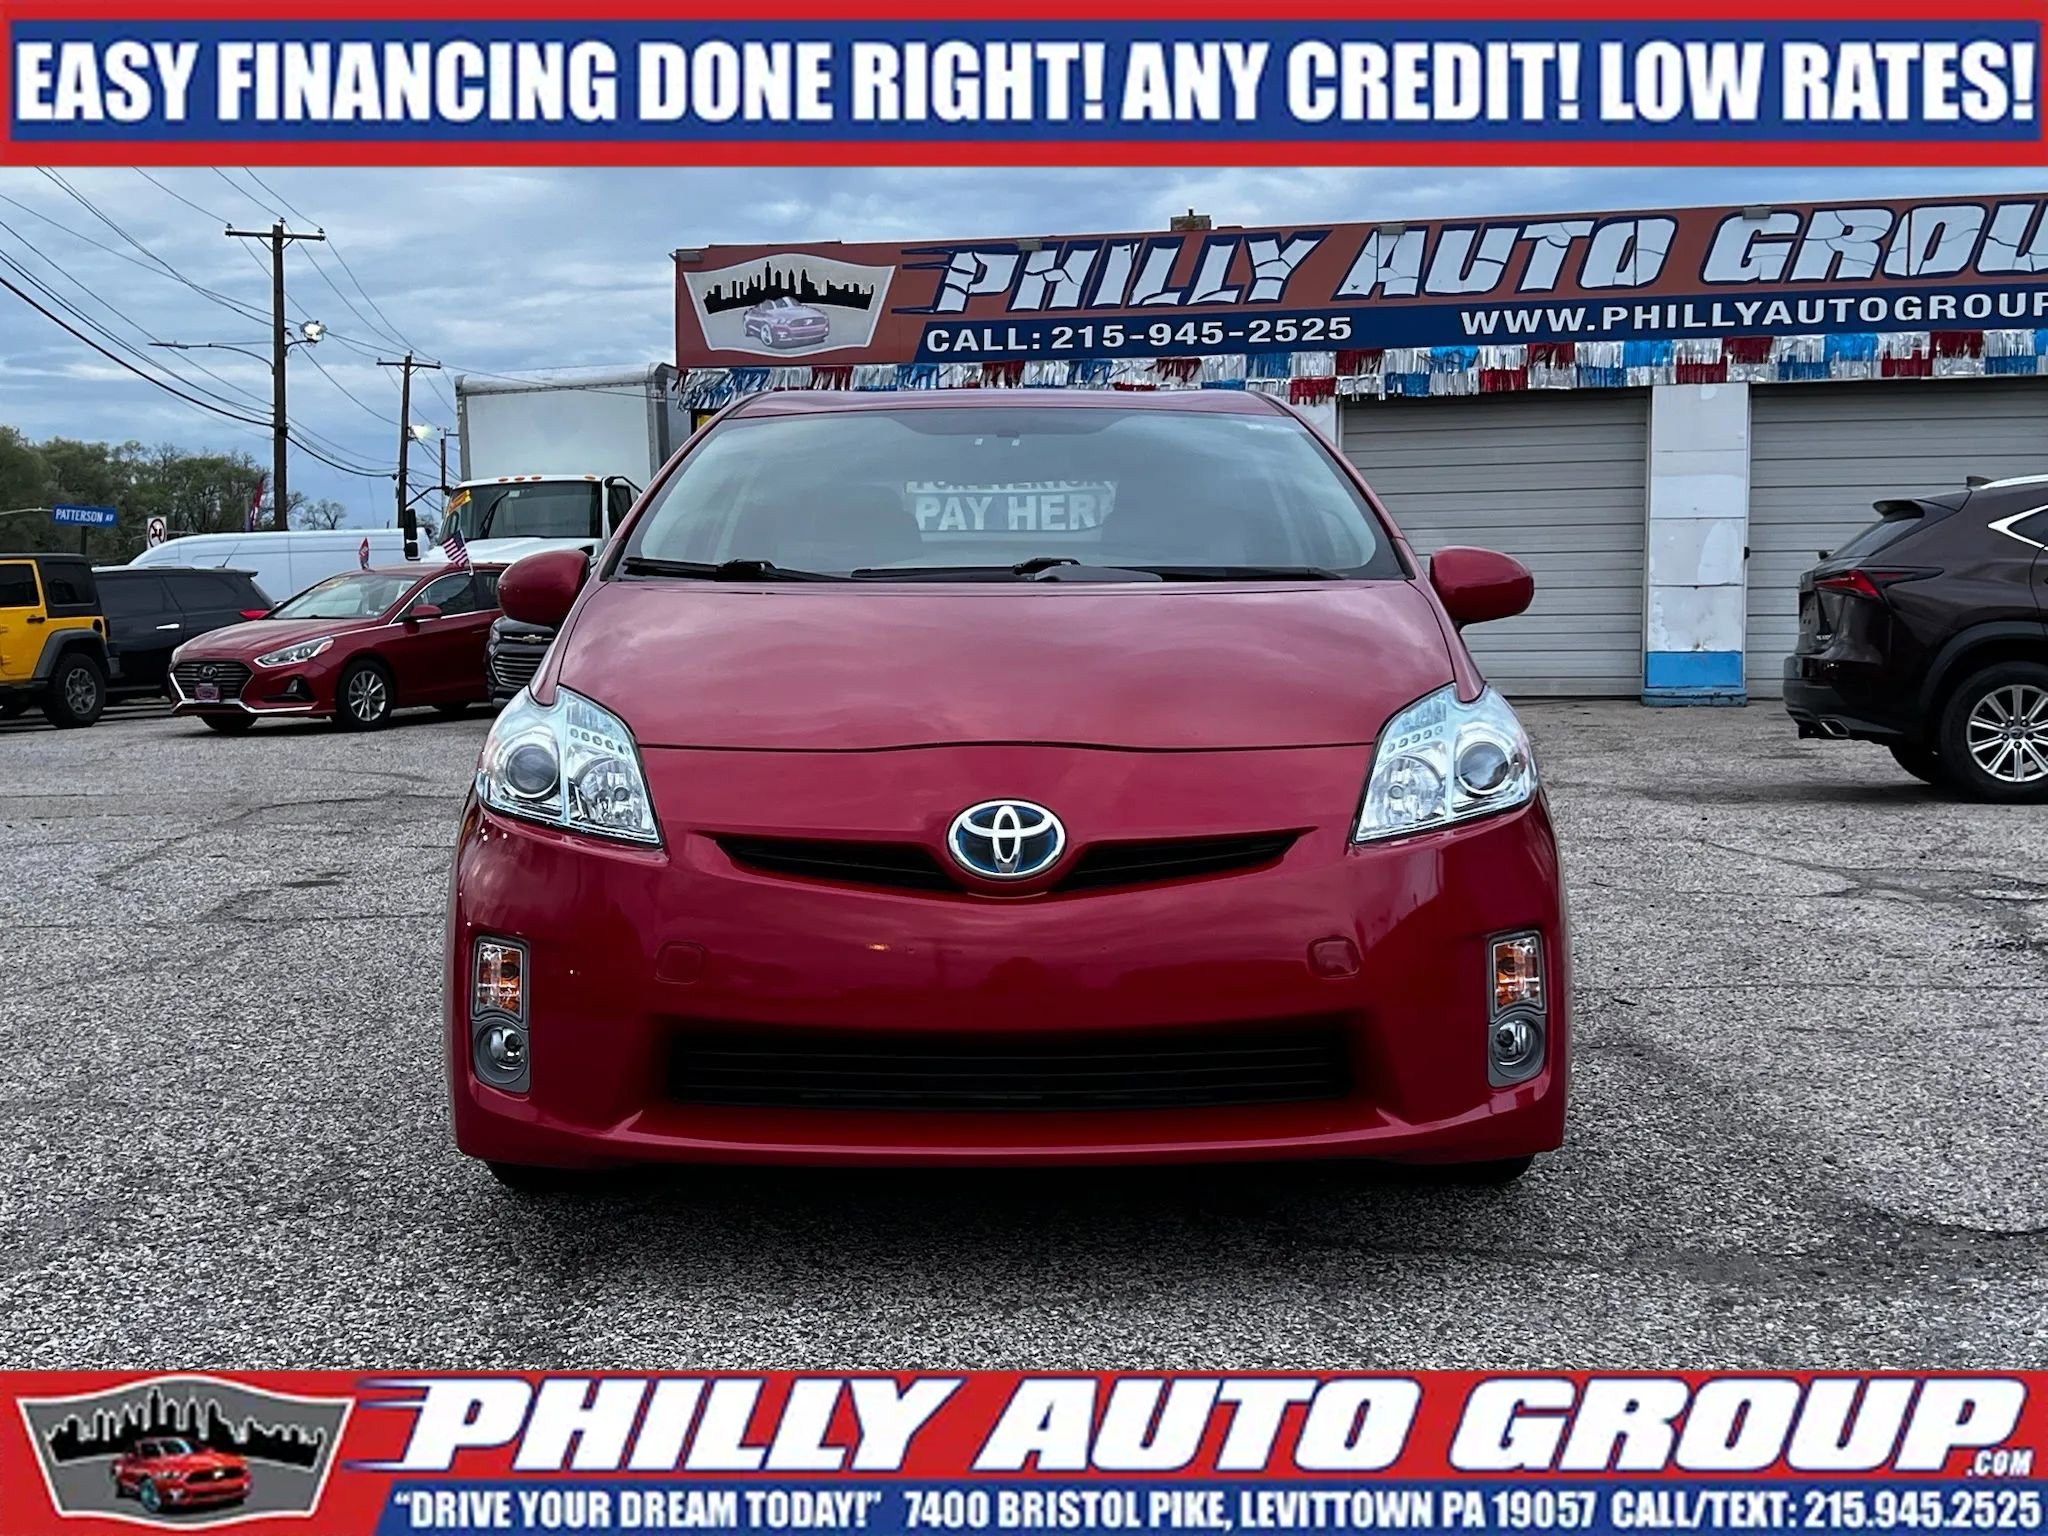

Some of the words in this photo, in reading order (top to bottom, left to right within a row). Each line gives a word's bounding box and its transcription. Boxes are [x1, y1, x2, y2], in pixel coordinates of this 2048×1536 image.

[932, 235, 1326, 315] PHILLY
[1334, 218, 1678, 298] AUTO
[926, 325, 1040, 353] CALL:
[1051, 316, 1353, 350] 215-945-2525
[55, 508, 103, 523] PATTERSON
[915, 495, 993, 531] PAY
